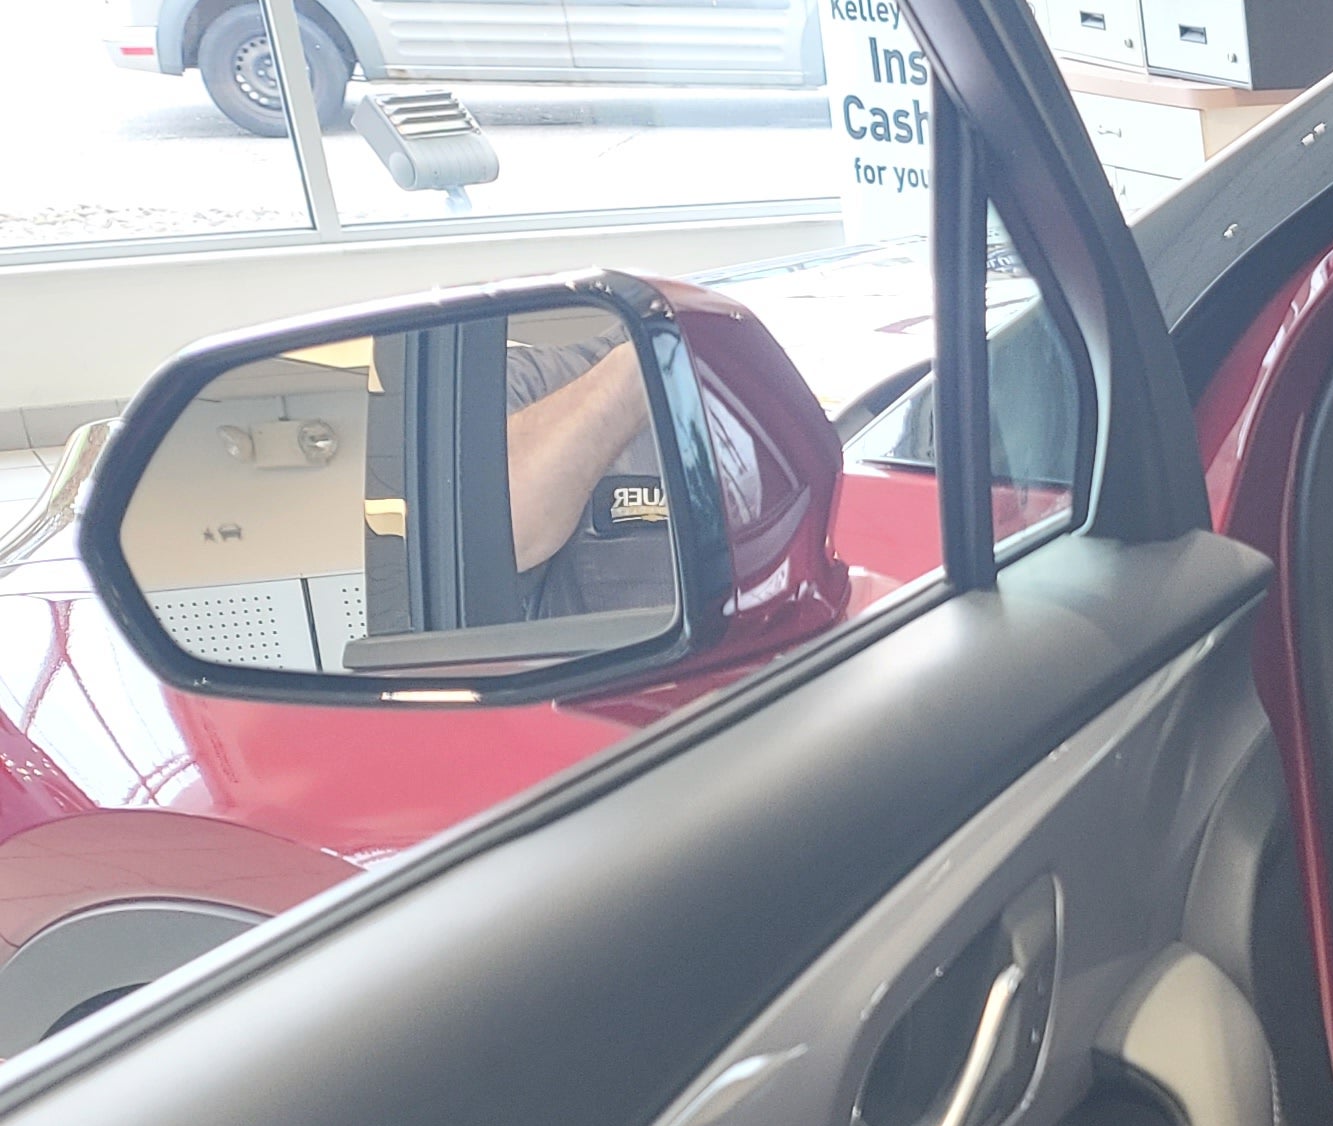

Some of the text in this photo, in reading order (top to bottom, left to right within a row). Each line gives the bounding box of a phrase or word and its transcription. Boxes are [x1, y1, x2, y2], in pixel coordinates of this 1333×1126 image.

[831, 0, 900, 30] Kelley
[843, 94, 929, 145] Cash
[854, 157, 887, 186] for
